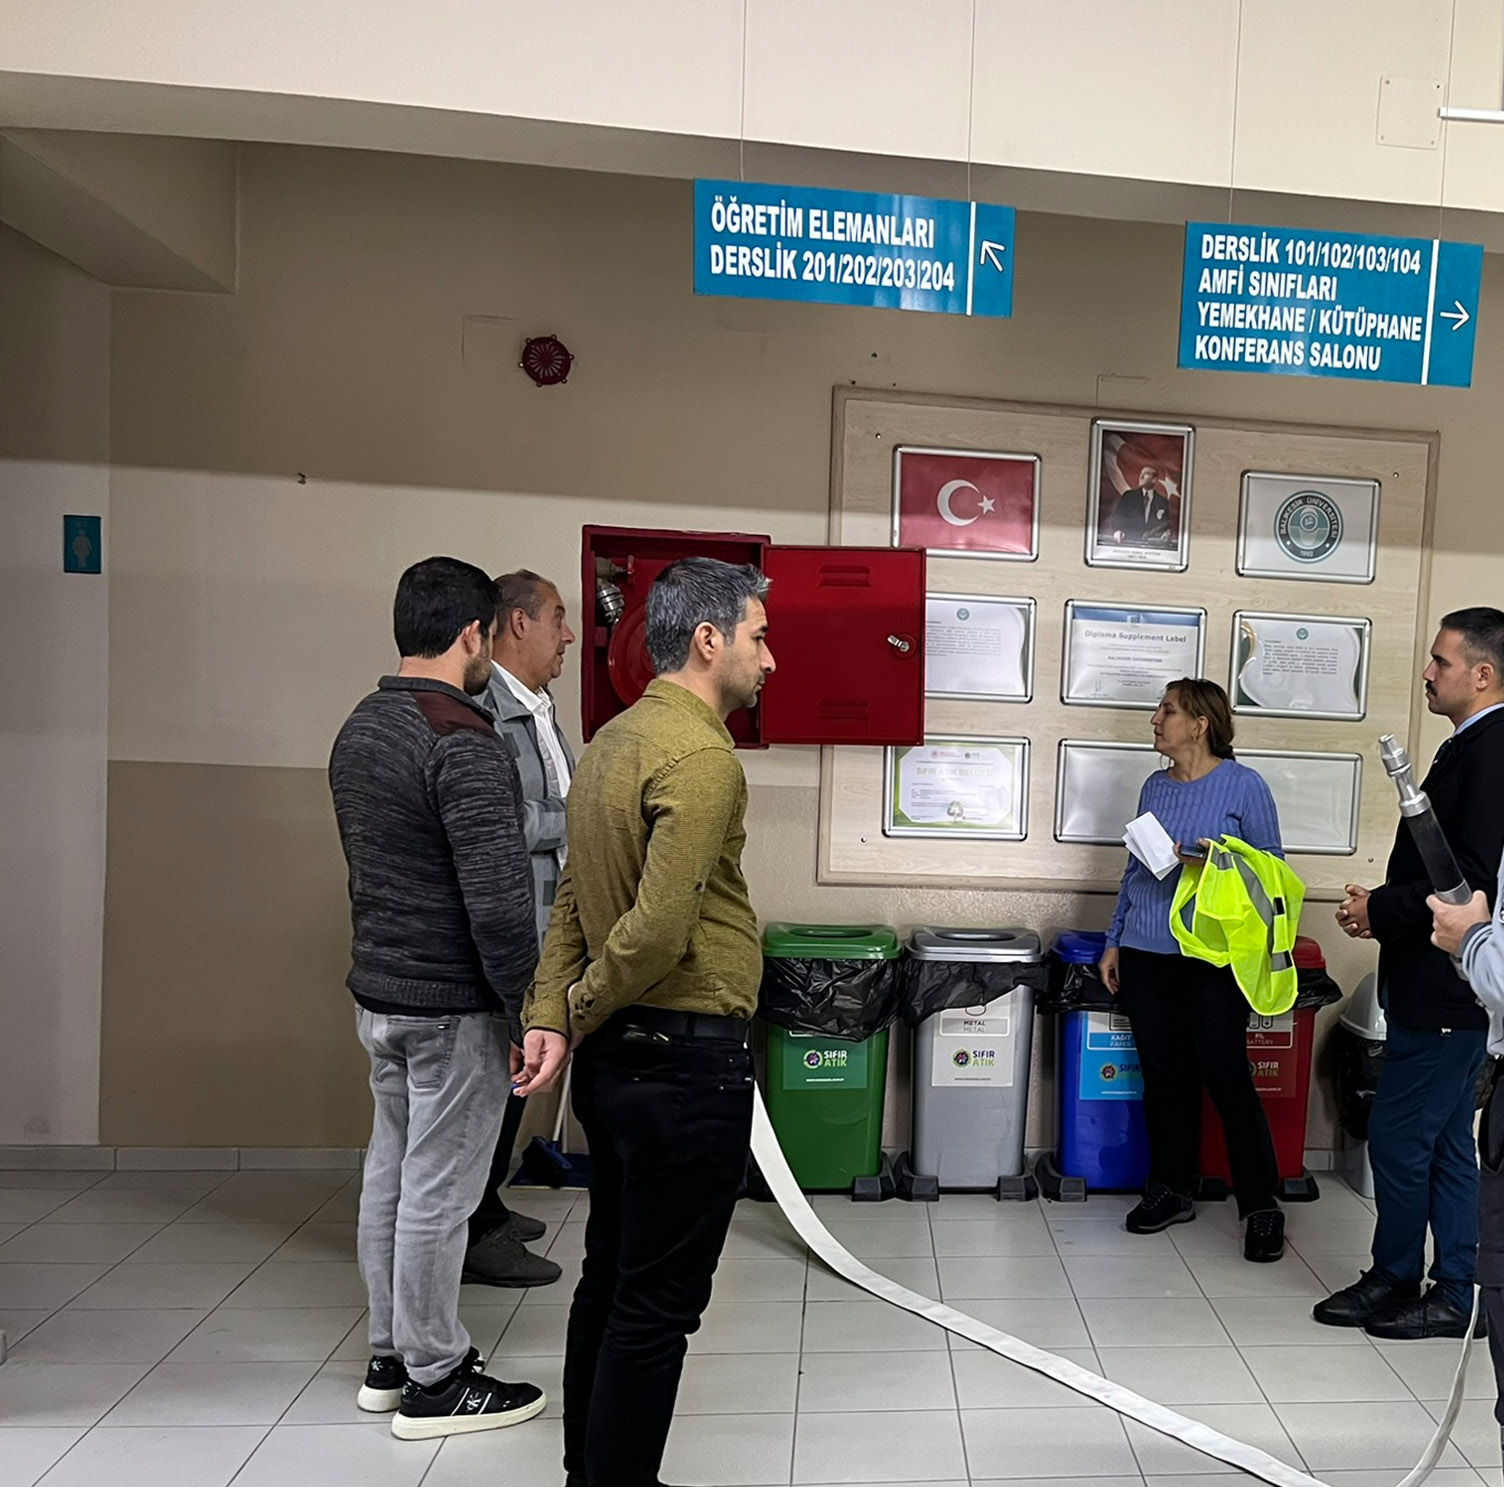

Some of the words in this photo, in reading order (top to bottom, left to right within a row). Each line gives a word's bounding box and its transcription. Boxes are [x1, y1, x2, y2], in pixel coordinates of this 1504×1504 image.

[711, 195, 803, 238] ÖĞRETİM
[809, 209, 935, 249] ELEMANLARI
[710, 241, 797, 280] DERSLİK
[1201, 232, 1281, 264] DERSLİK
[1285, 239, 1421, 275] 101/102/103/104
[1198, 264, 1245, 295] AMFİ
[1248, 272, 1338, 301] SINIFLARI
[1197, 301, 1306, 333] YEMEKHANE
[1319, 305, 1423, 341] KÜTÜPHANE
[1194, 334, 1305, 366] KONFERANS
[1309, 344, 1382, 371] SALONU
[1084, 630, 1117, 639] Diploma
[1118, 632, 1164, 641] Supplement
[1165, 635, 1187, 643] Label
[824, 1050, 848, 1059] SIFIR
[824, 1059, 848, 1067] ATIK
[972, 1050, 995, 1058] SIFIR
[1257, 1061, 1279, 1069] SIFIR
